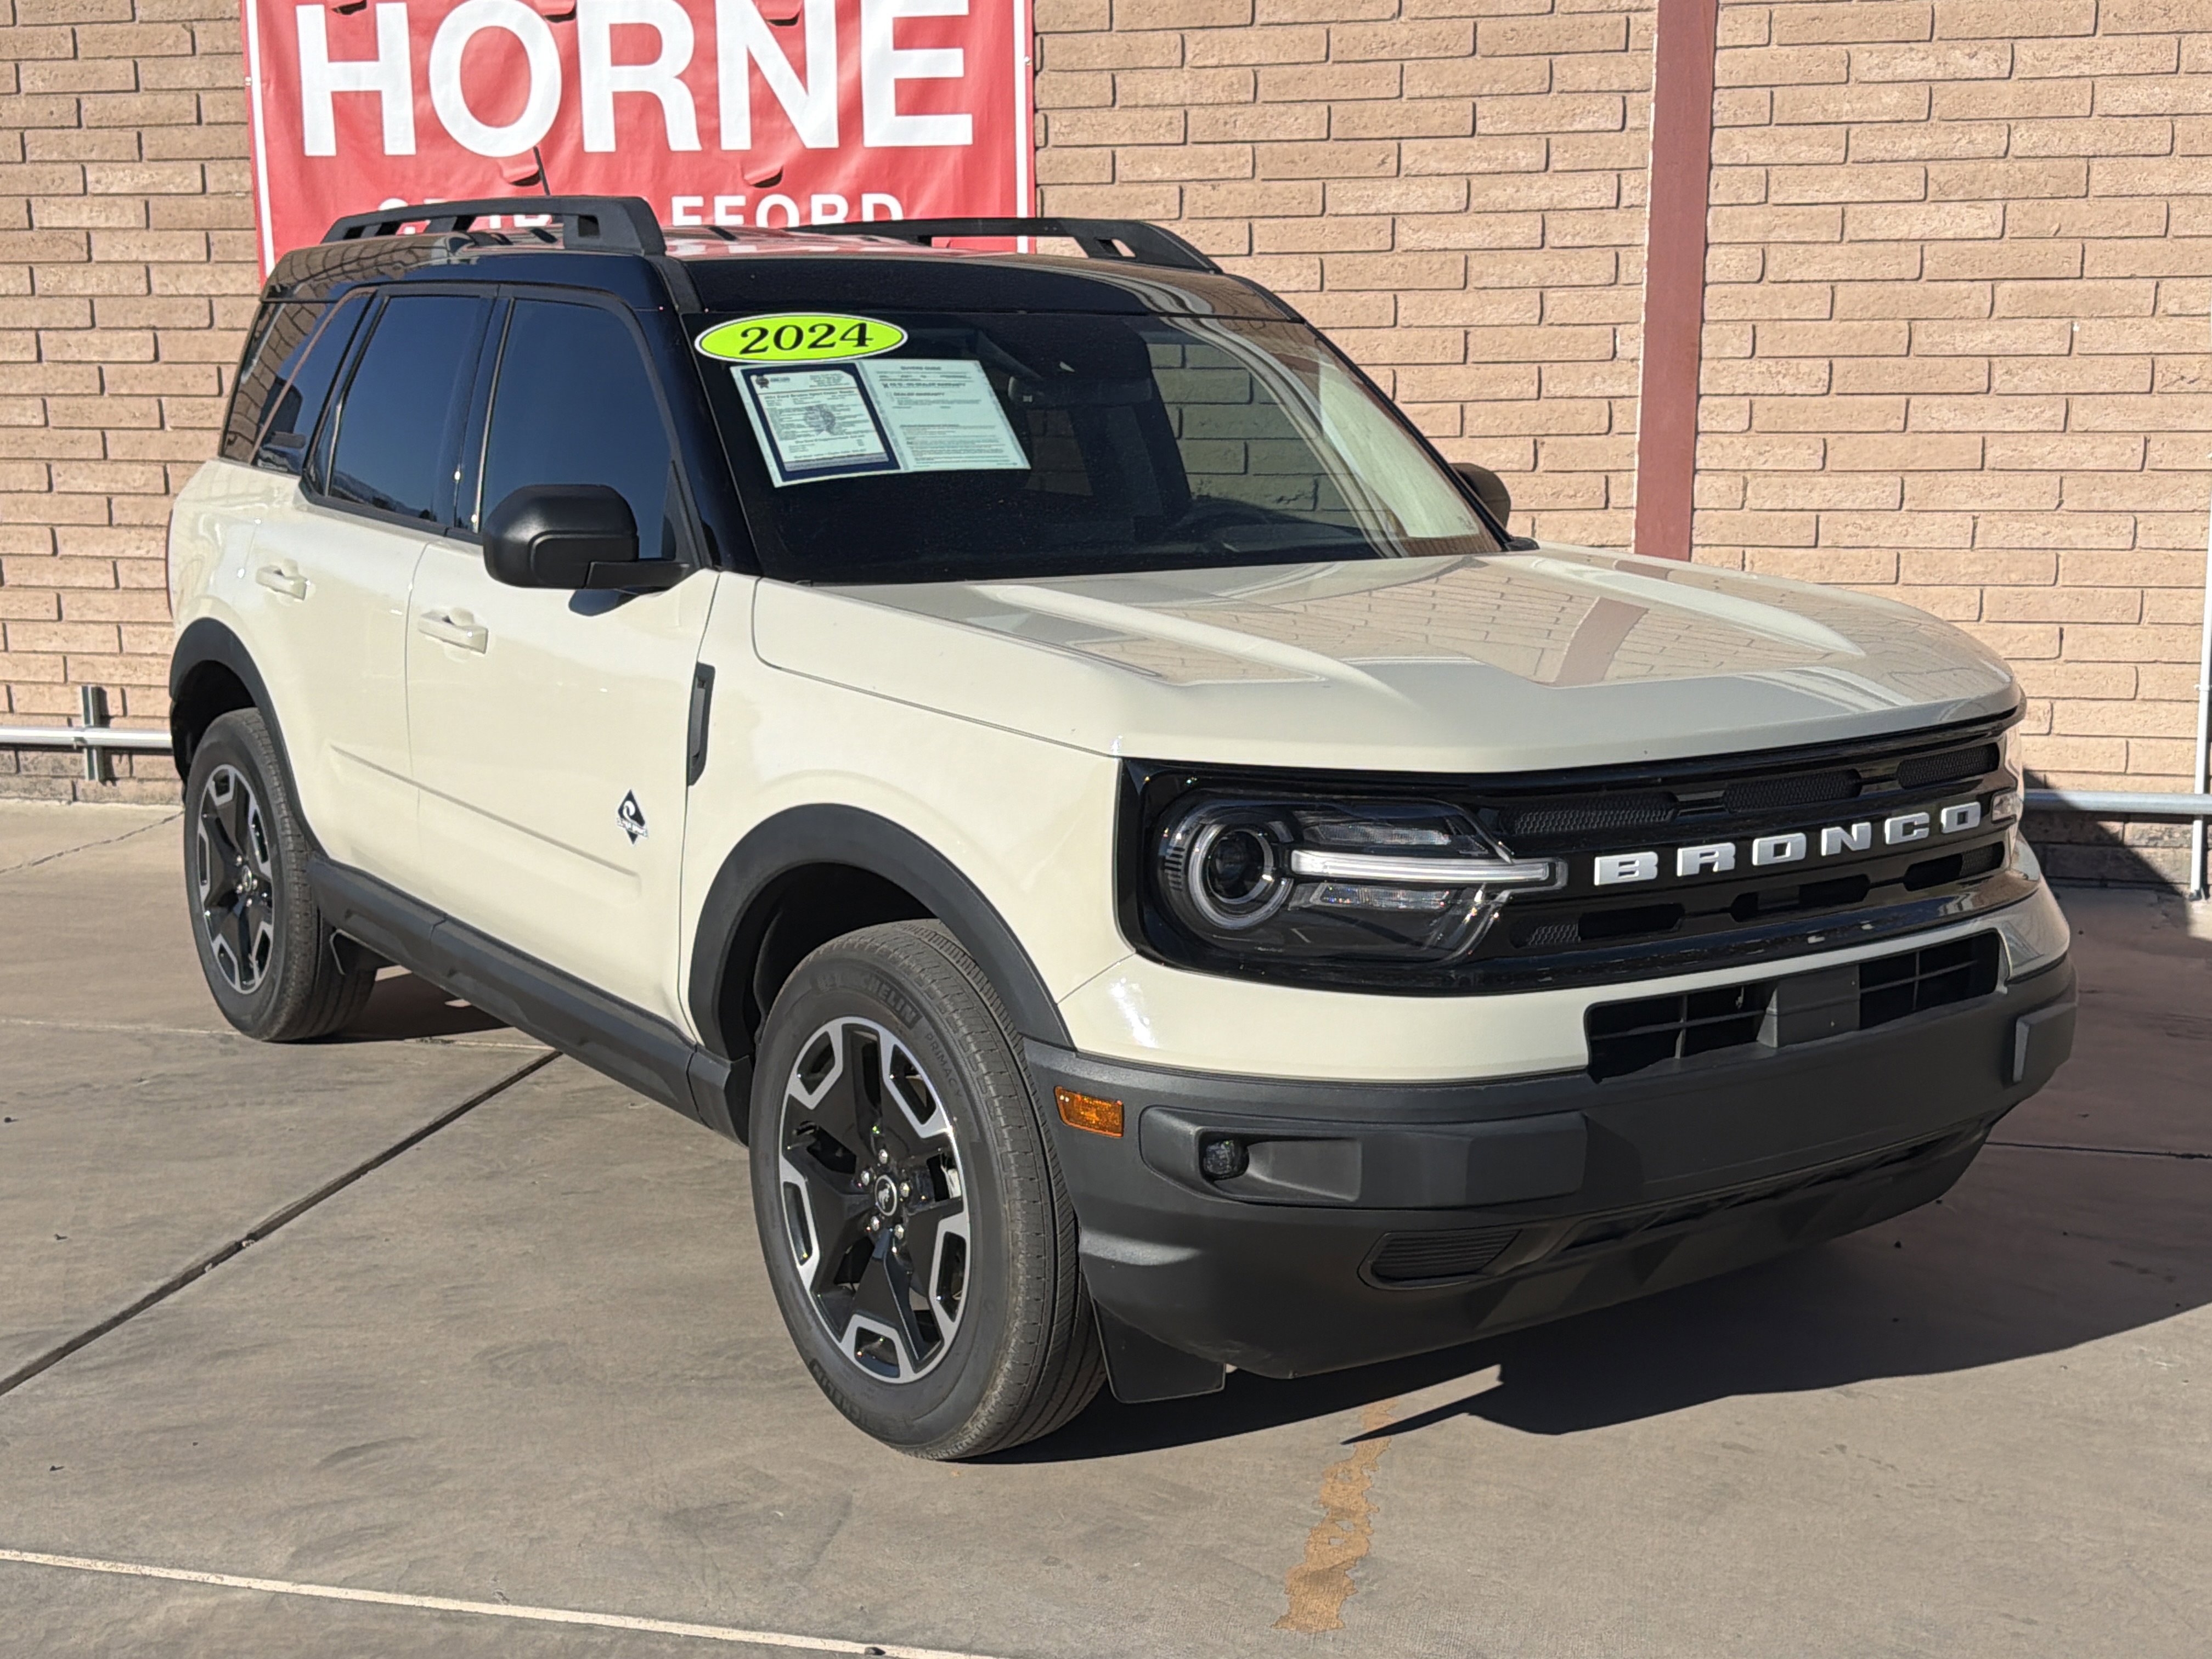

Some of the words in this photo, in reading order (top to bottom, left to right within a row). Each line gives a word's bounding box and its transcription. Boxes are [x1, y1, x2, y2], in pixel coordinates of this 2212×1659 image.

[300, 0, 973, 157] HORNE
[671, 193, 904, 228] FFORD
[739, 322, 874, 355] 2024
[1594, 801, 1982, 887] BRONCO
[843, 971, 917, 1024] CHELIN
[925, 1032, 962, 1097] PRIMACY
